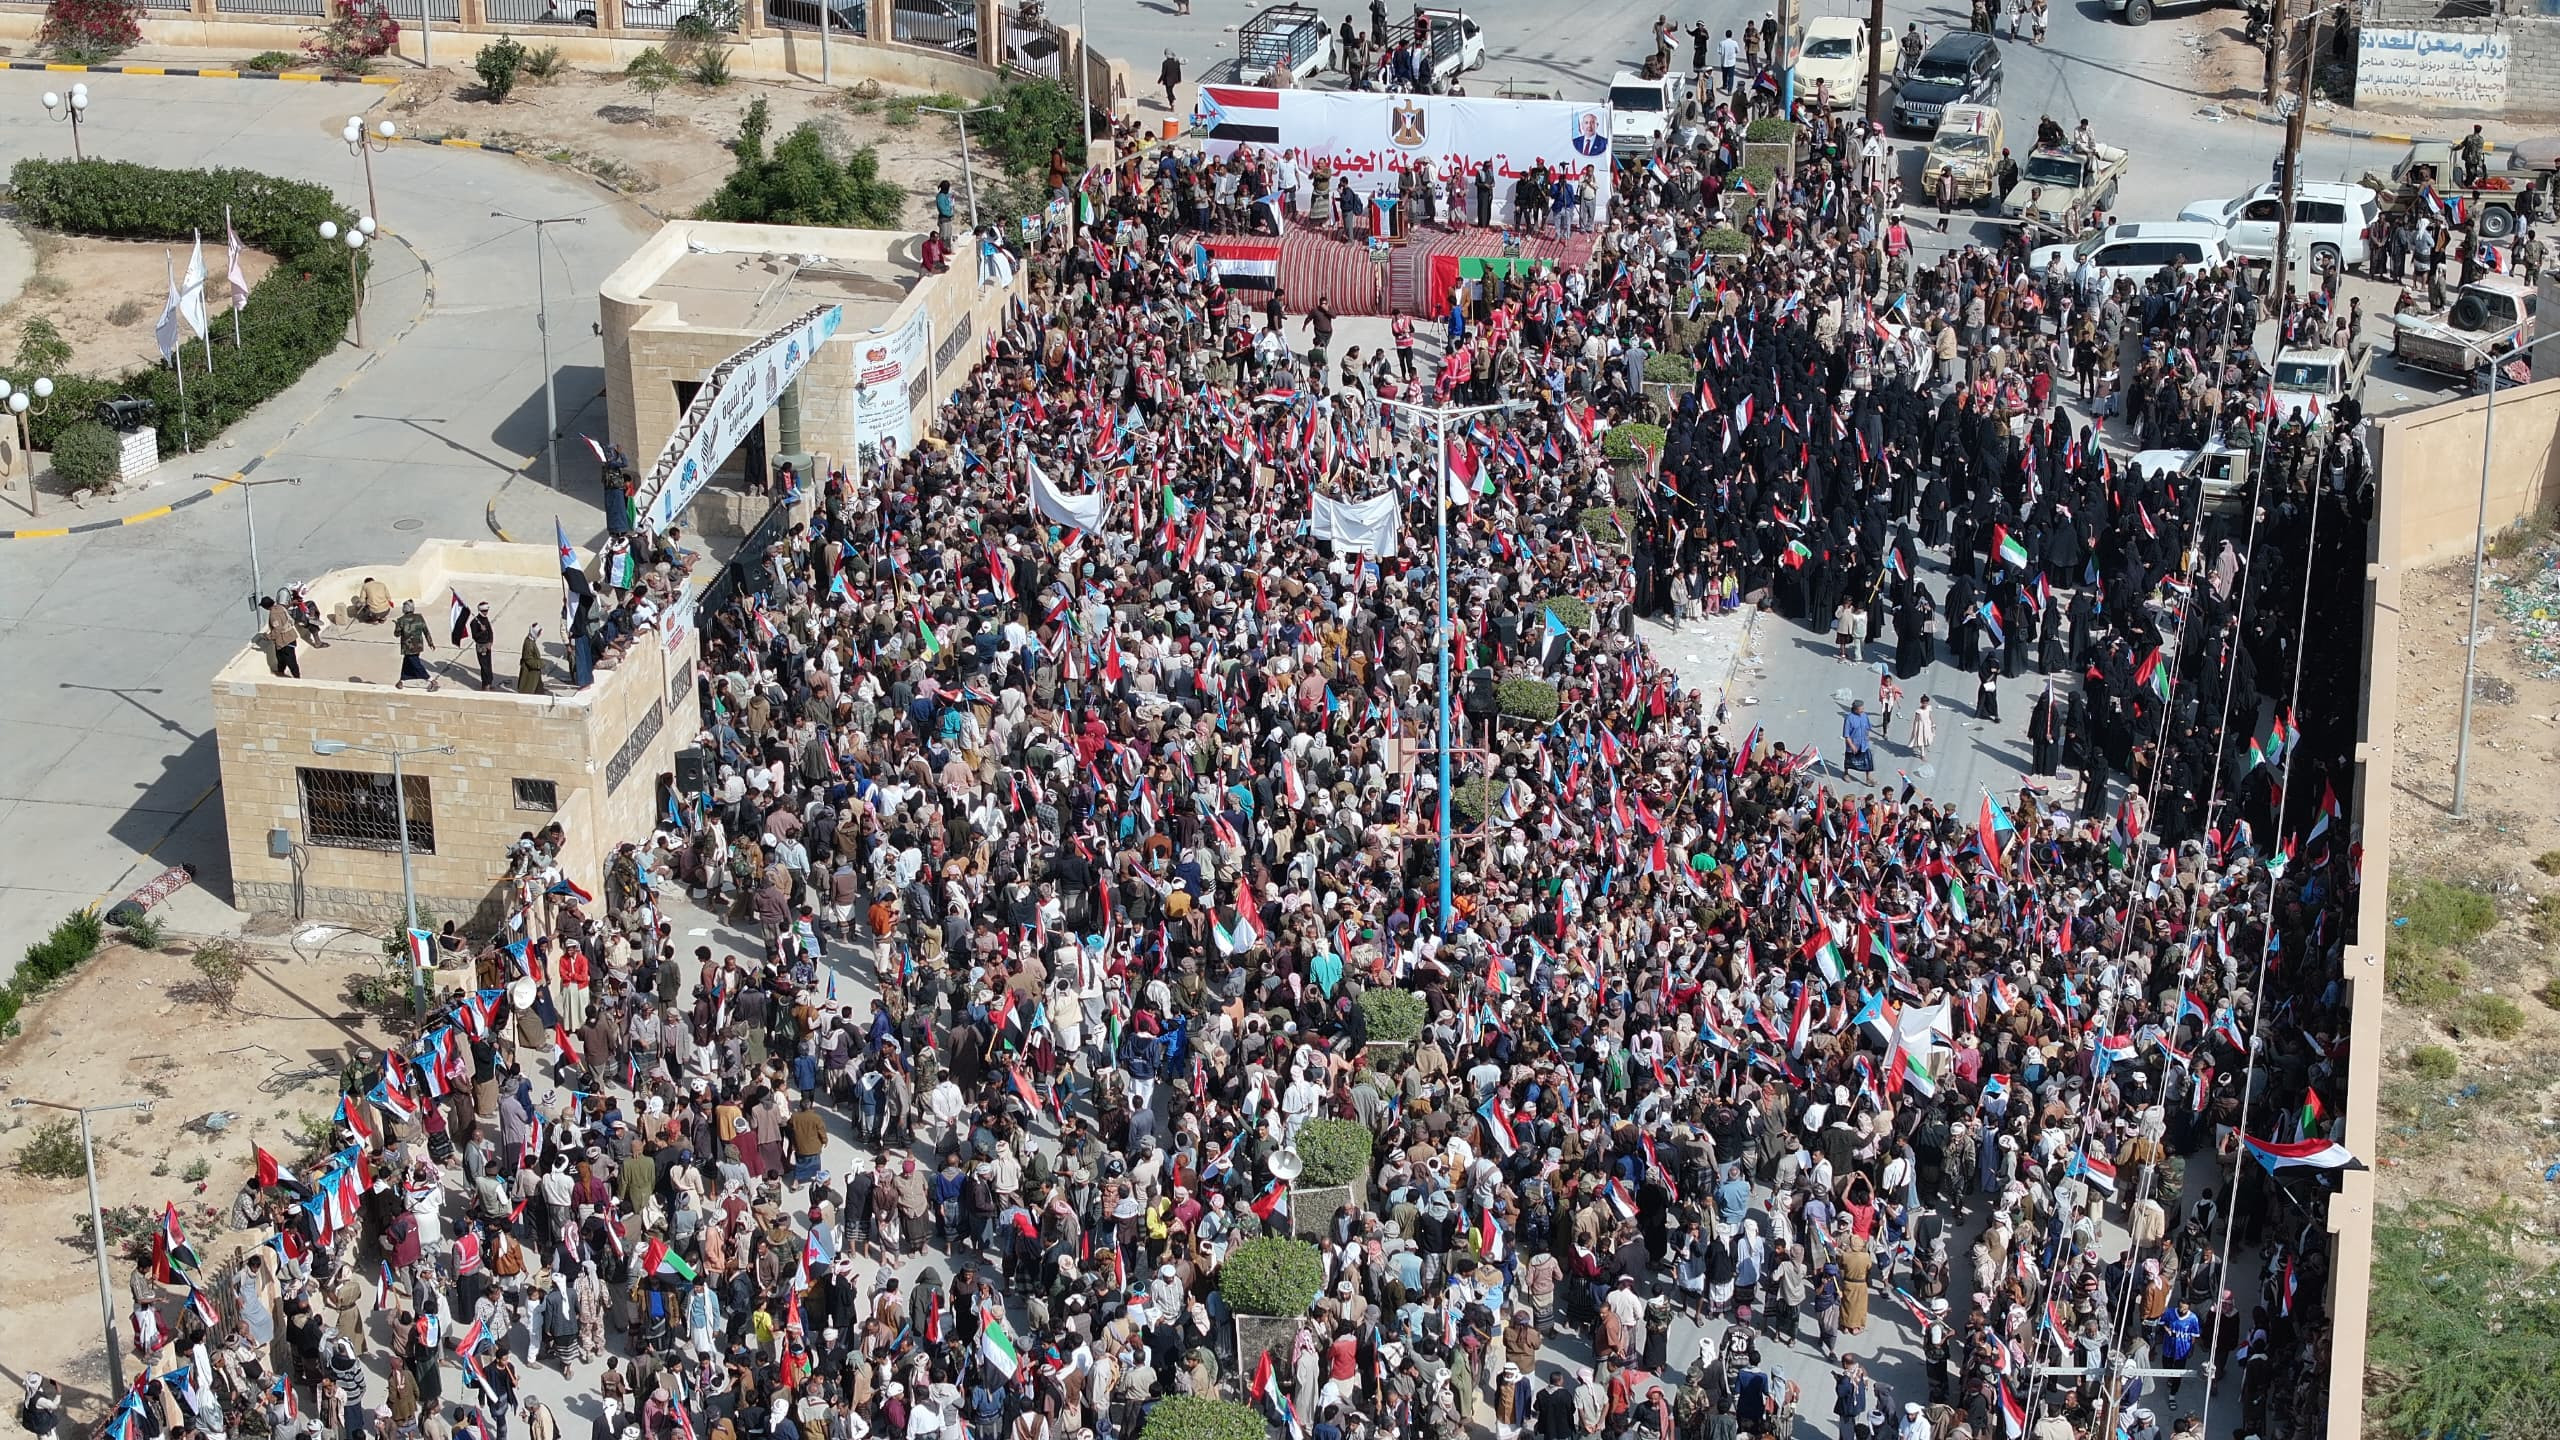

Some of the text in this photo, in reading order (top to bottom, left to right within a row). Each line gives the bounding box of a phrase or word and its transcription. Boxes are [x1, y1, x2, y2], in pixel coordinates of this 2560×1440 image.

[2417, 34, 2463, 56] معن
[741, 365, 757, 405] شاعر
[722, 384, 740, 420] شبوة
[1731, 1336, 1747, 1352] 20
